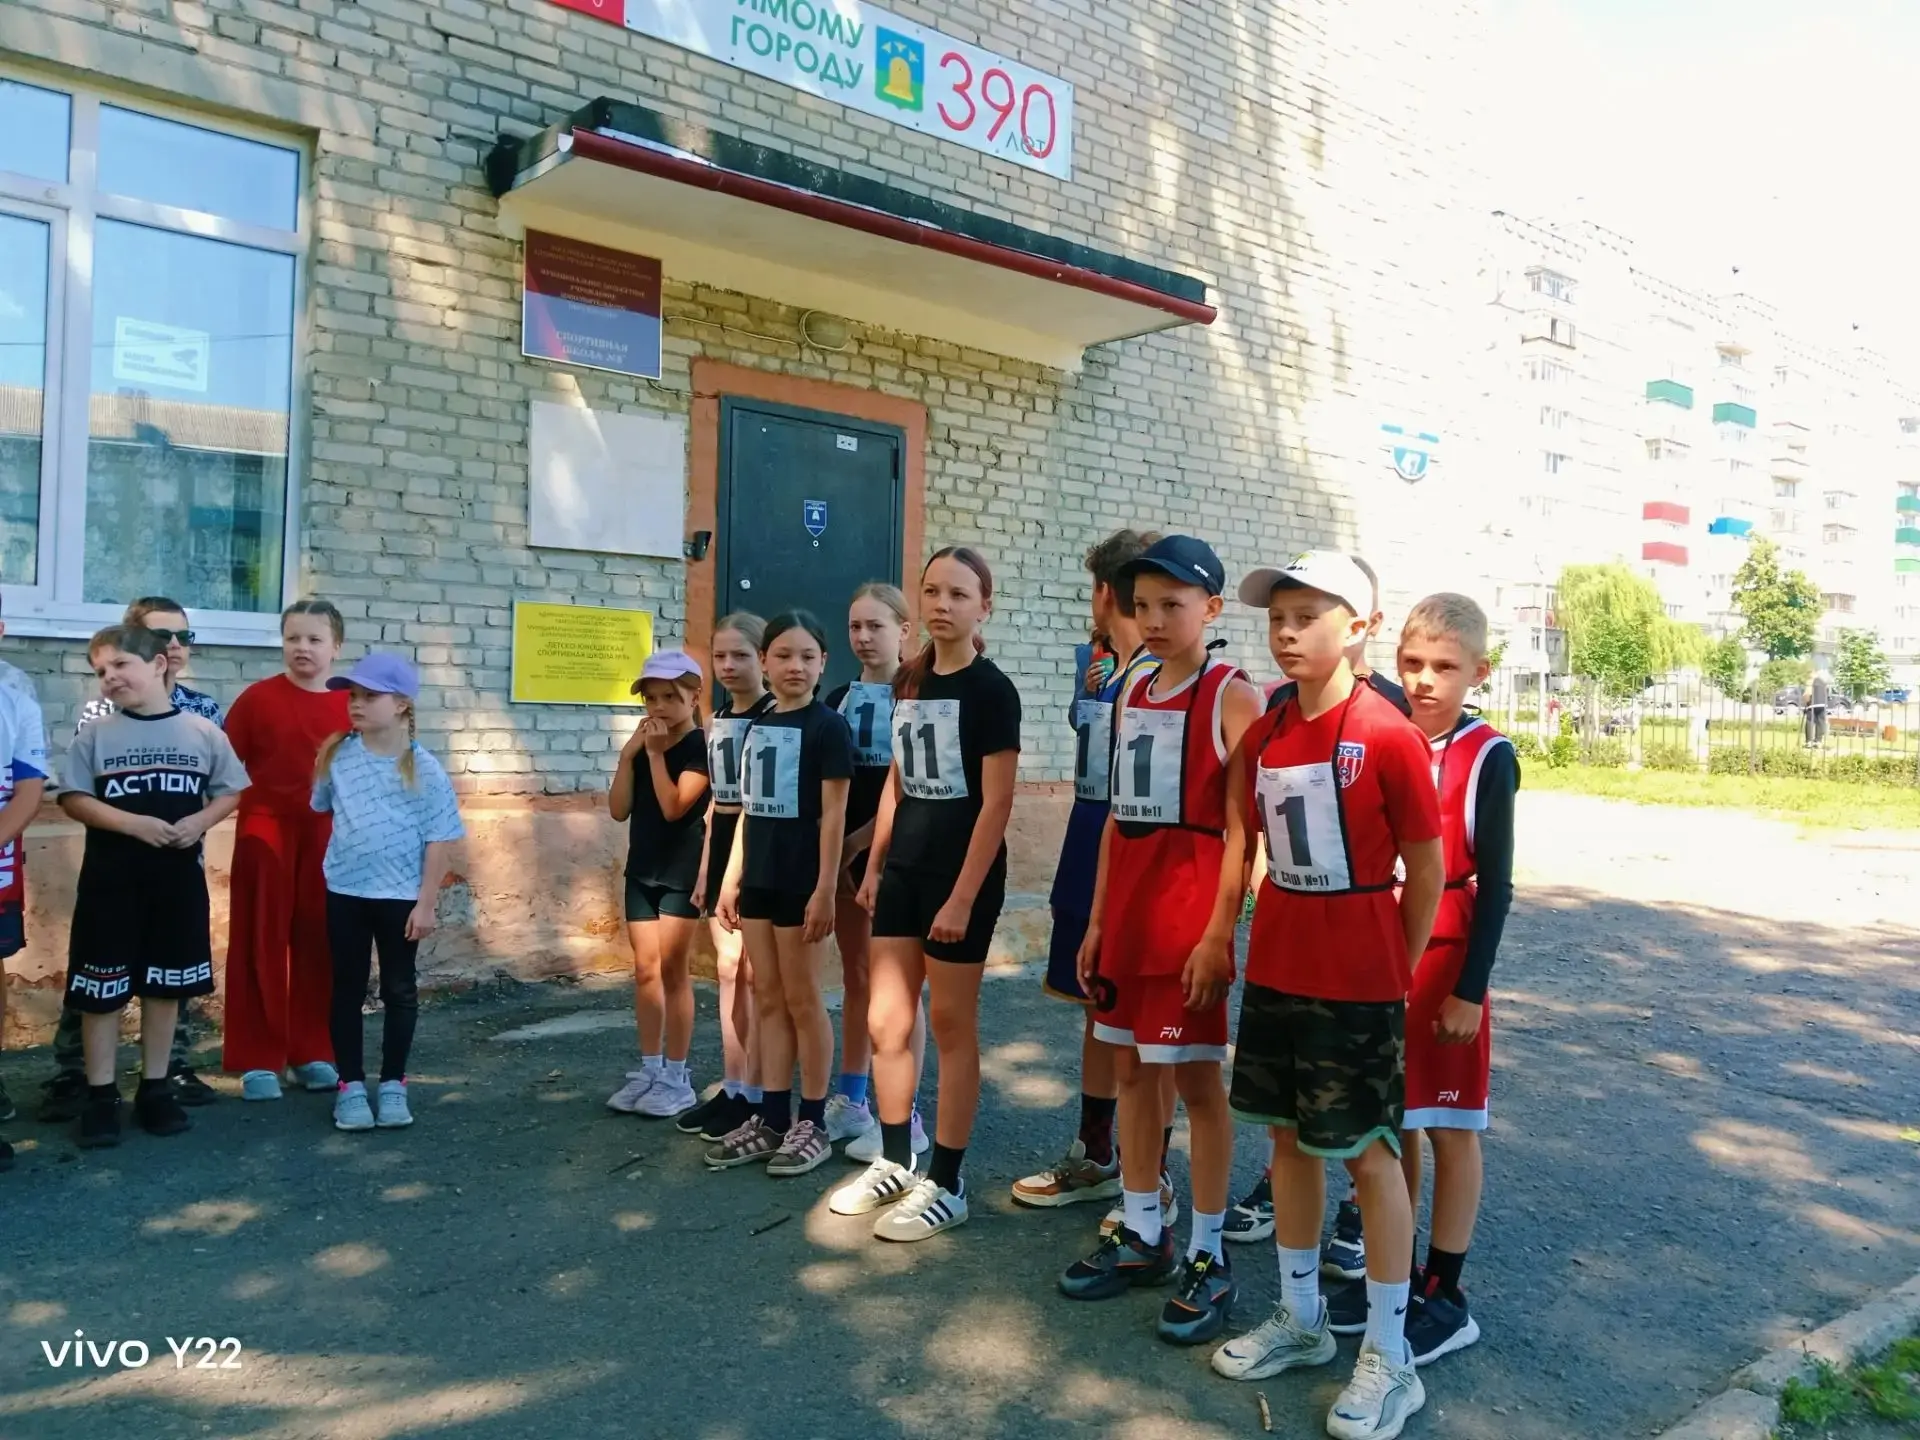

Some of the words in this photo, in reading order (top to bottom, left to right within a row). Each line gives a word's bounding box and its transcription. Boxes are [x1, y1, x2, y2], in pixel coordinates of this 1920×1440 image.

[731, 15, 864, 89] ГОРОДУ
[937, 52, 1056, 158] 390
[103, 753, 199, 770] PROGRESS
[898, 722, 939, 779] 11
[1142, 805, 1162, 817] №11
[1305, 875, 1329, 886] №11
[71, 974, 130, 999] PROG
[146, 961, 211, 986] RESS
